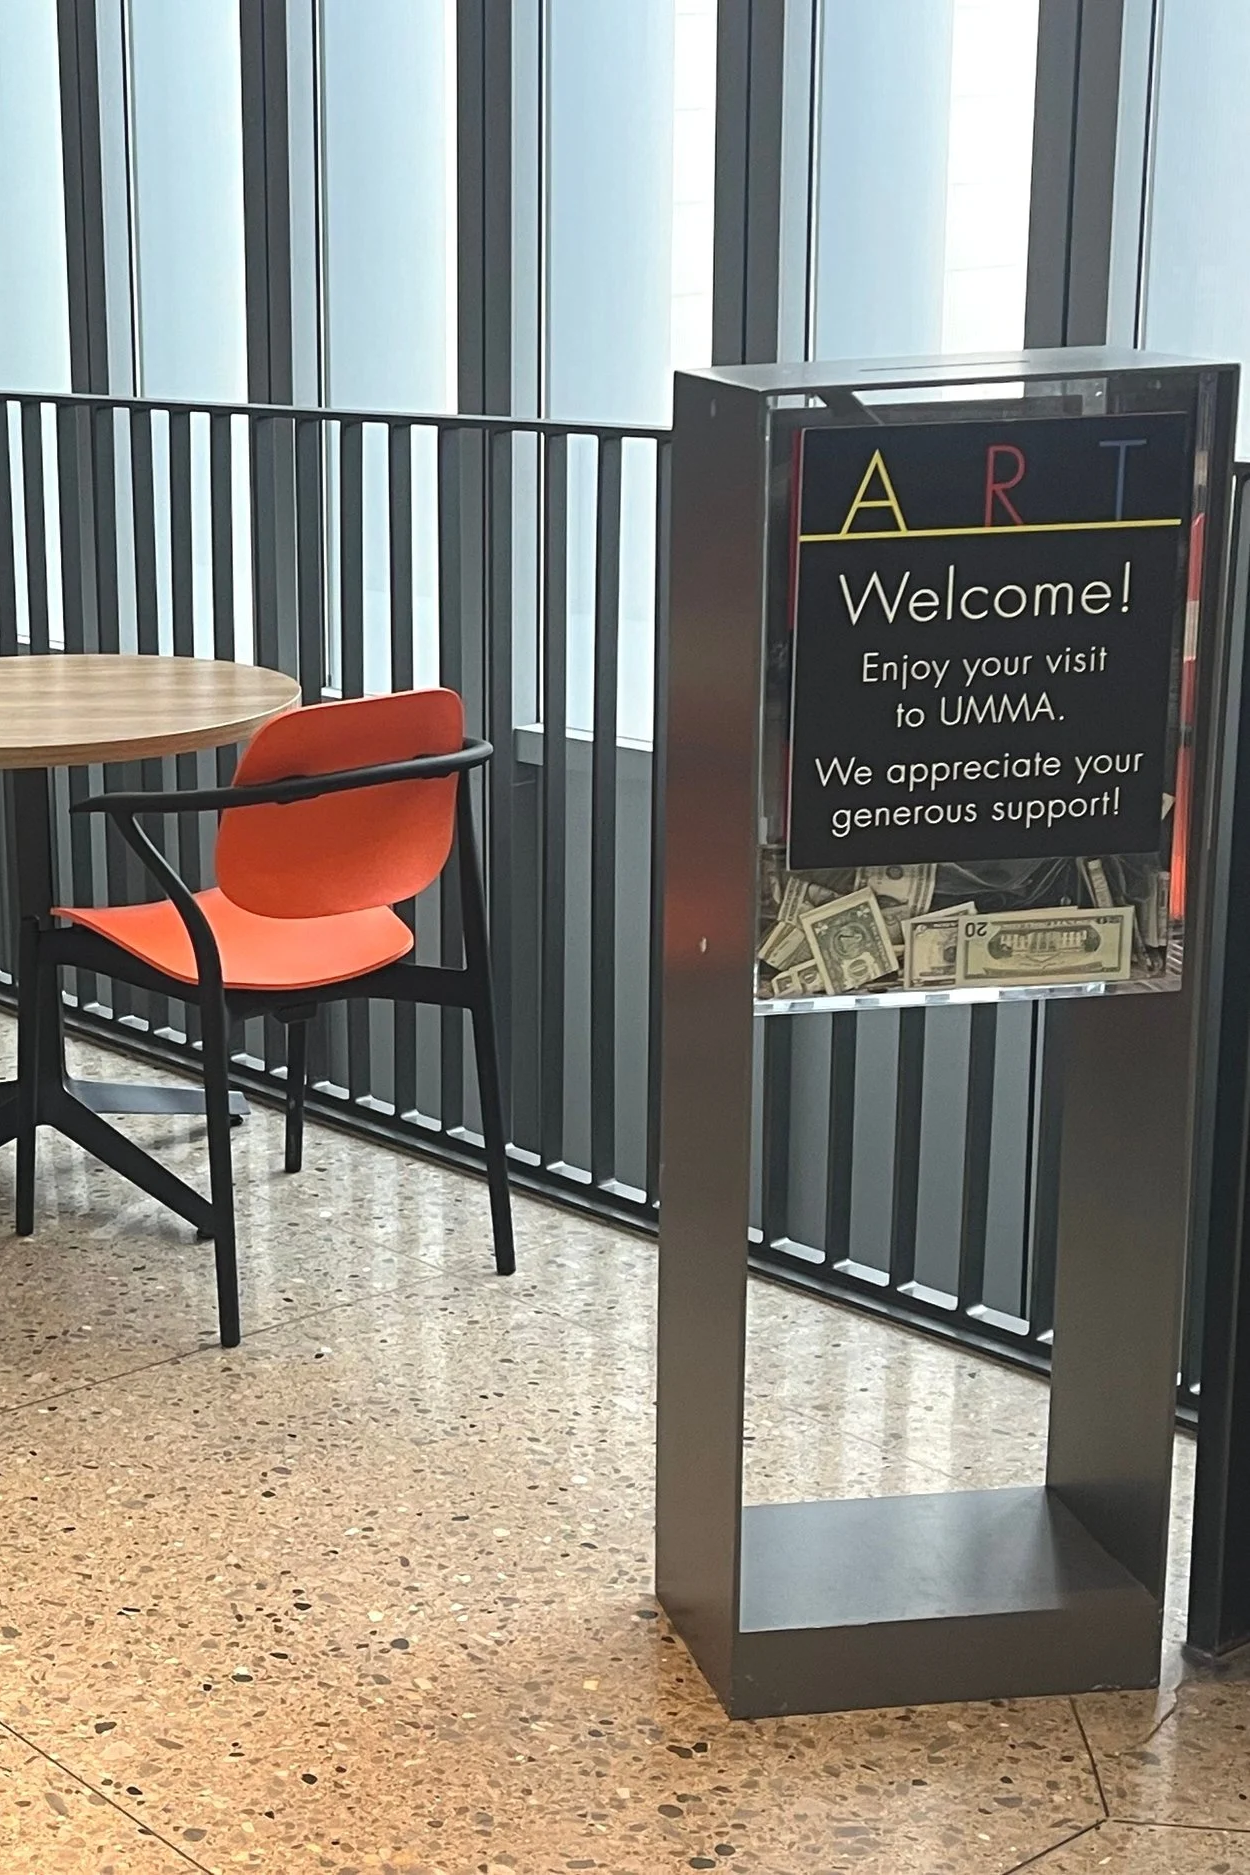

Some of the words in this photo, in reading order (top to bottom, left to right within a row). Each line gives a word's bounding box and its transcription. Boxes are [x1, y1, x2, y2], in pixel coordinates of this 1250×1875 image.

[839, 562, 1130, 625] Welcome!
[863, 652, 950, 690] Enjoy
[963, 656, 1032, 687] your
[1046, 646, 1107, 673] visit
[897, 703, 924, 727] to
[941, 692, 1064, 725] UMMA.
[815, 757, 872, 786] We
[887, 752, 1061, 792] appreciate
[1075, 753, 1143, 784] your
[832, 804, 977, 837] generous
[992, 787, 1119, 828] support!
